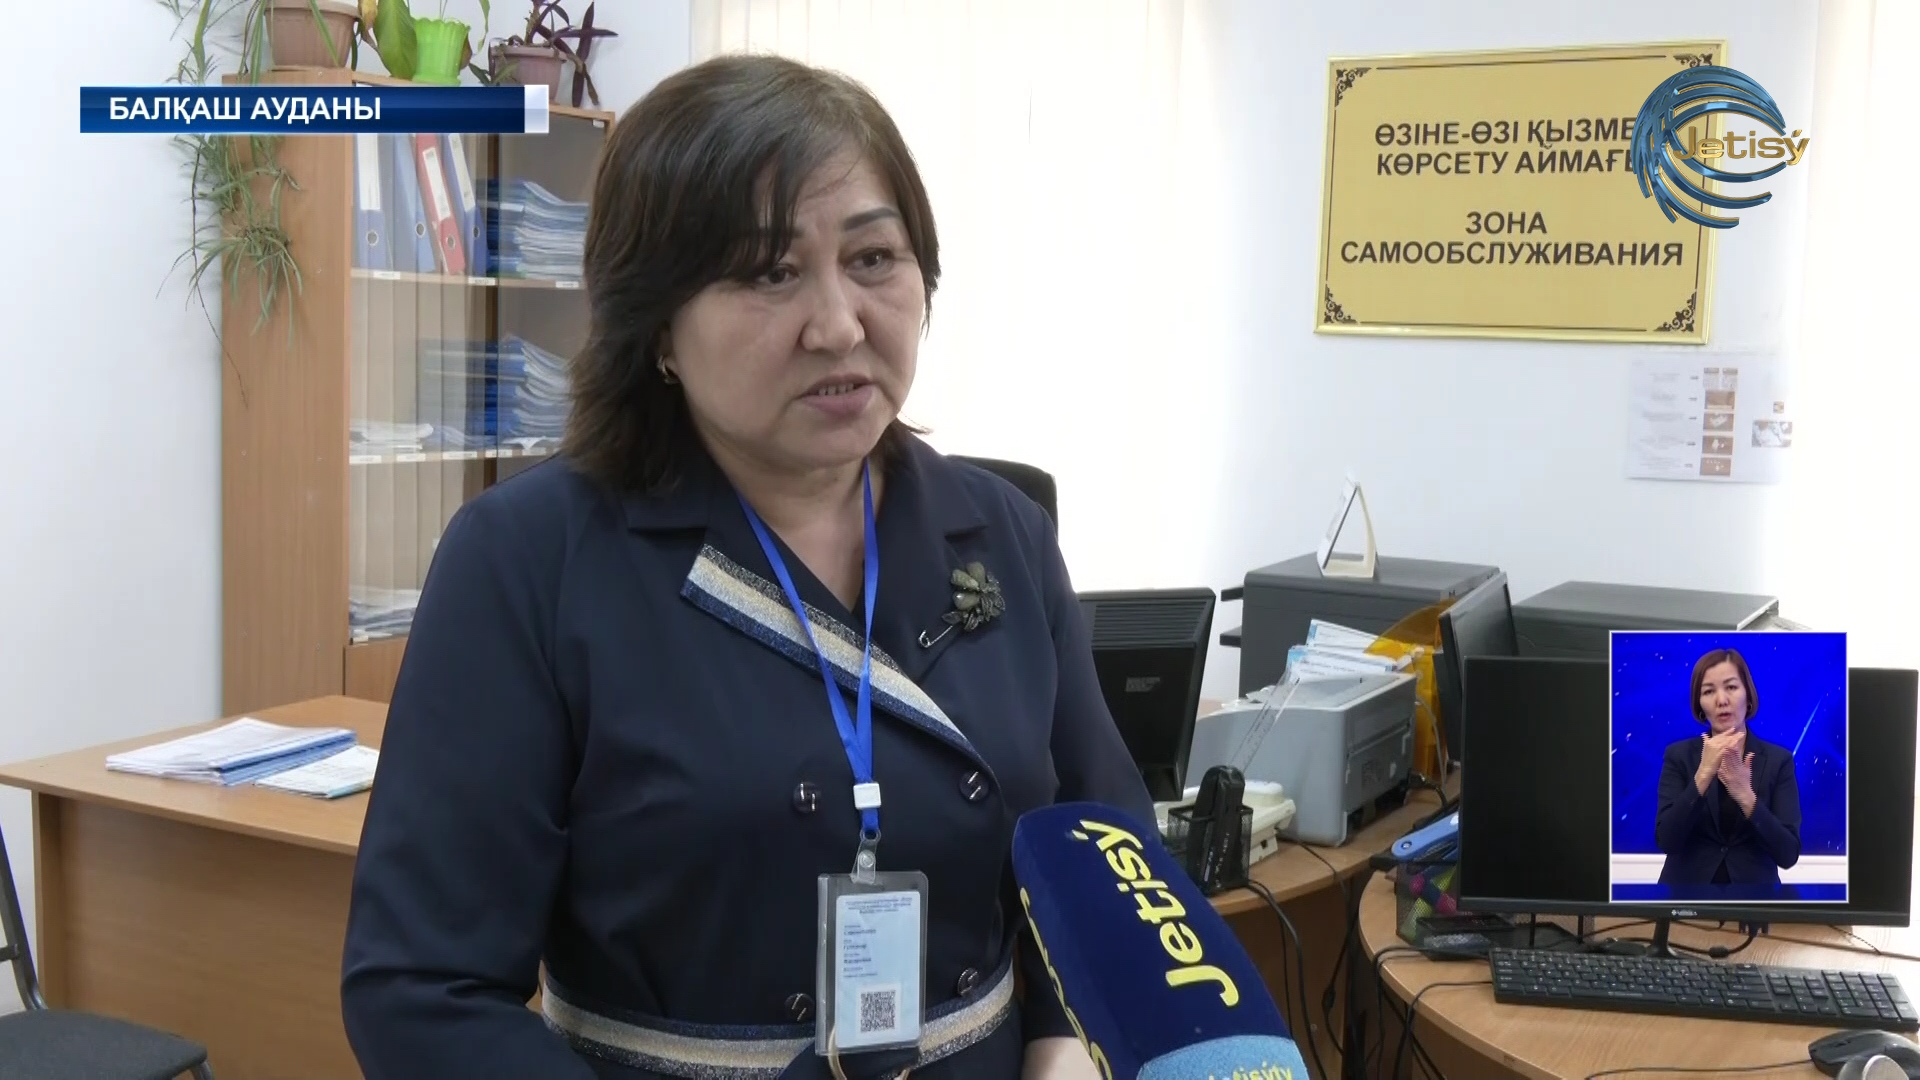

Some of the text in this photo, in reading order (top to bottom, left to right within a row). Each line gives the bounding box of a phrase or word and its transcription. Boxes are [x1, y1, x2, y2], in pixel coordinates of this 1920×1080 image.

[1375, 117, 1637, 148] ӨЗІНЕ-ӨЗІ ҚЫЗМЕ
[1377, 151, 1510, 176] КӨРСЕТУ
[1465, 211, 1548, 235] ЗОНА
[1340, 241, 1684, 267] САМООБСЛУЖИВАНИЯ
